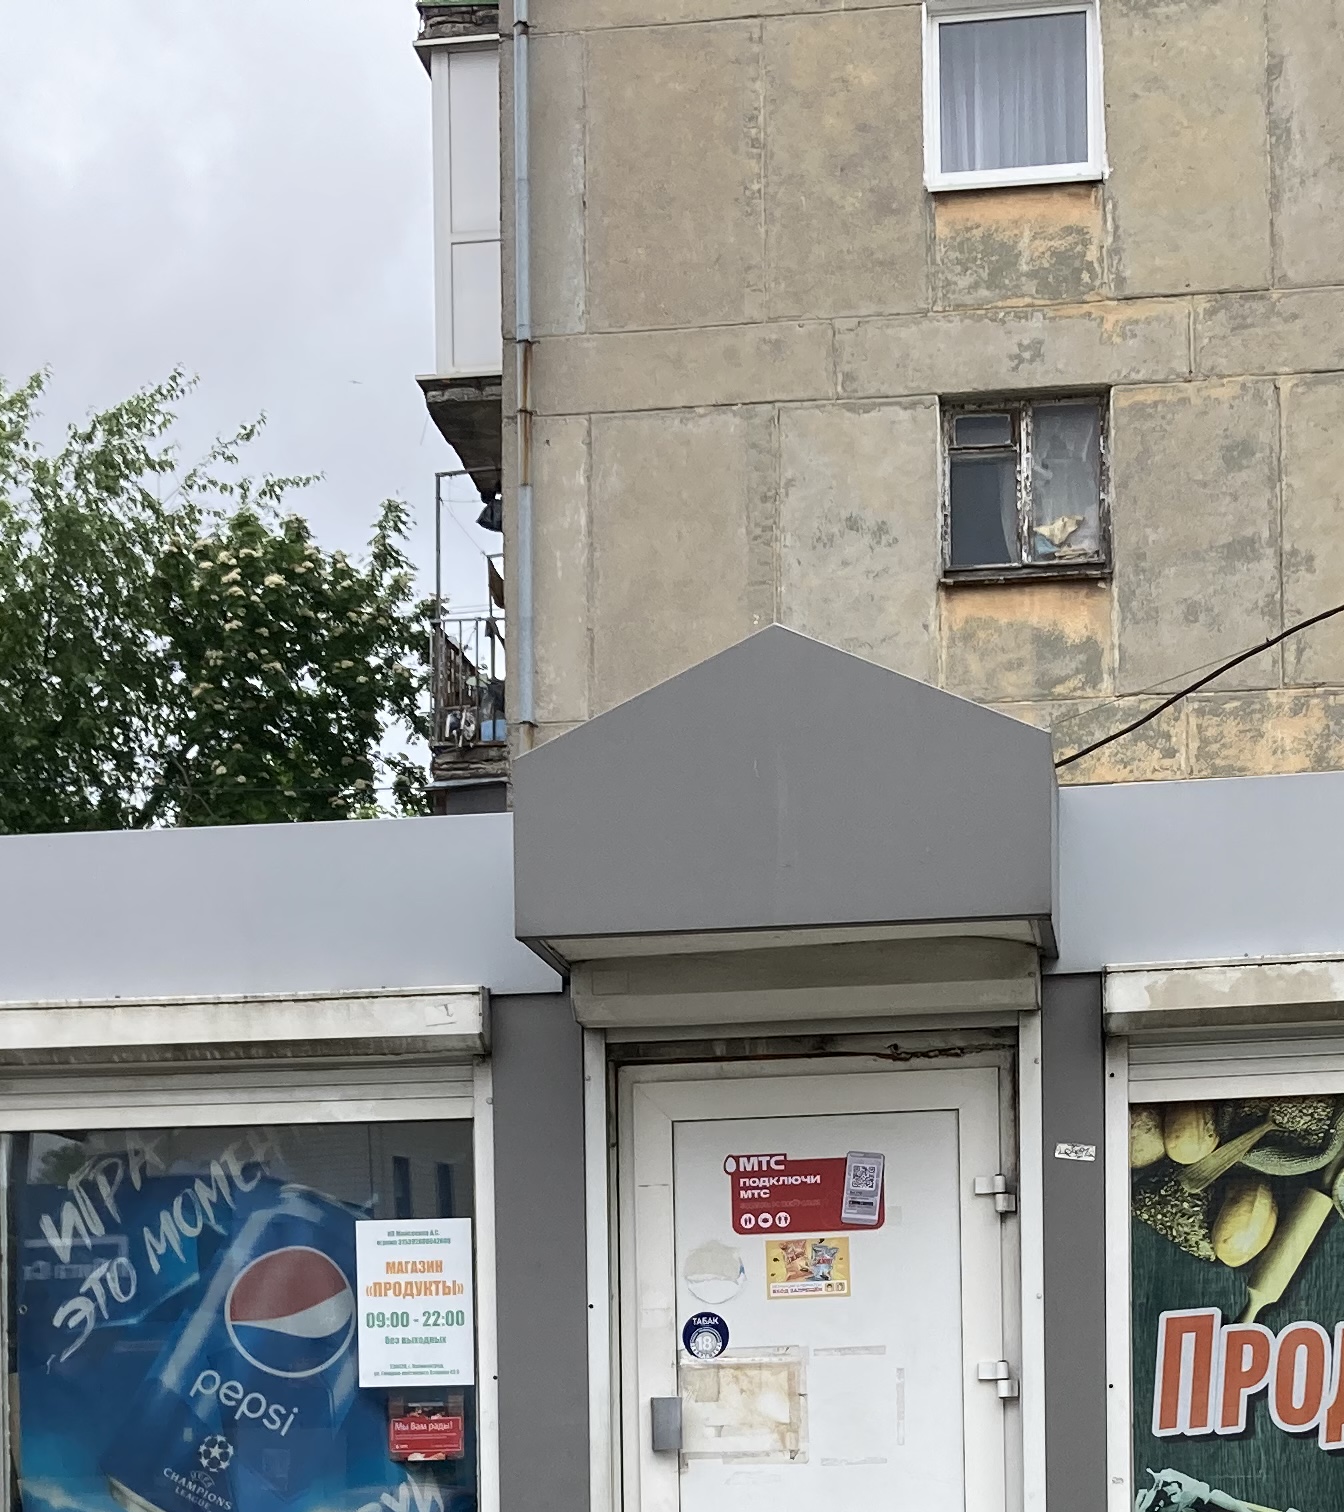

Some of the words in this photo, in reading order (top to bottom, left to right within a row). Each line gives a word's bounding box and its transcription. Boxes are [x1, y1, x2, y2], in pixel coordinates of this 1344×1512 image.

[739, 1155, 786, 1172] МТС
[739, 1174, 821, 1187] ПОДКЛЮЧИ
[739, 1189, 770, 1199] МТС
[52, 1257, 137, 1363] ЭТО
[142, 1126, 302, 1276] МОМЕН
[385, 1260, 443, 1274] МАГАЗИН
[366, 1280, 464, 1299] «ПРОДУКТЫ»
[366, 1311, 410, 1328] 09:00
[422, 1310, 465, 1327] 22:00
[692, 1316, 719, 1325] ТАБАК
[189, 1369, 299, 1437] pepsi
[428, 1421, 453, 1431] рады!
[163, 1468, 233, 1511] CHAMPIONS
